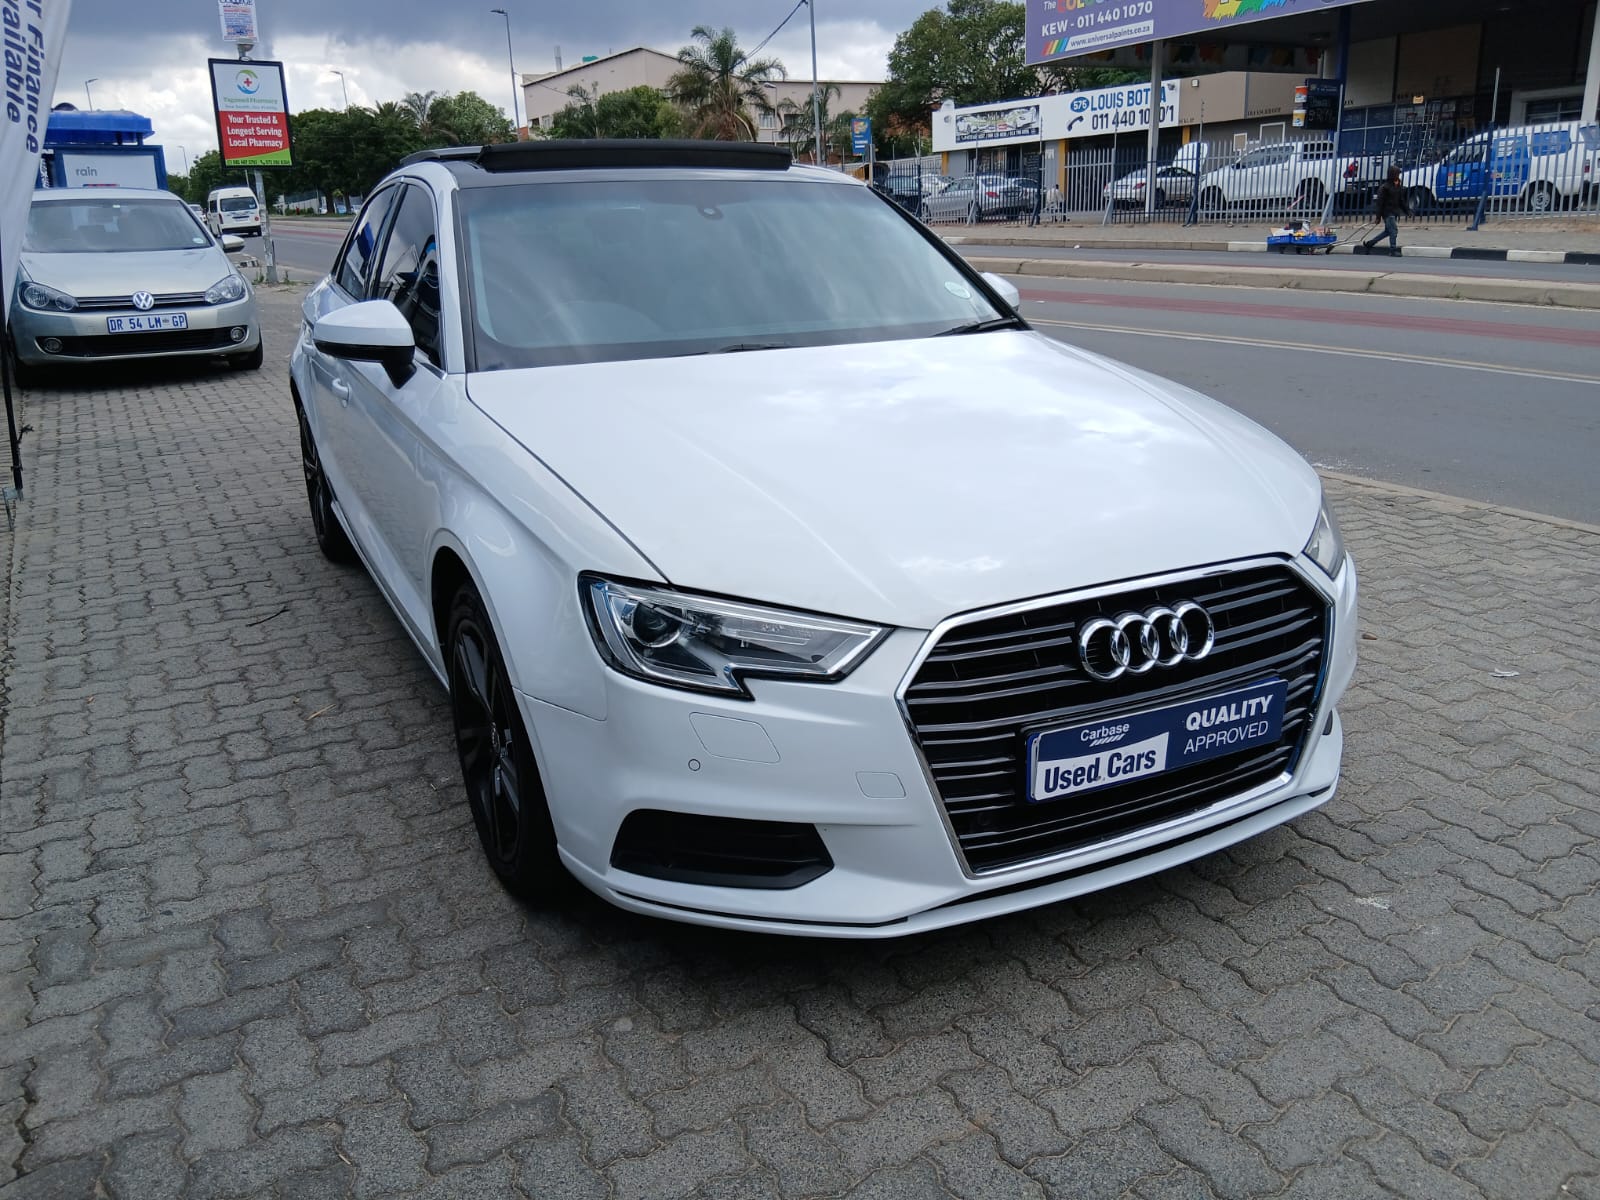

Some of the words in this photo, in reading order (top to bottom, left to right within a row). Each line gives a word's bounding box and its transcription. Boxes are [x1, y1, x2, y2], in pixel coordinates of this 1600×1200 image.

[1042, 20, 1068, 37] KEW
[1077, 13, 1094, 29] 011
[1097, 9, 1120, 24] 440
[1123, 1, 1153, 18] 1070
[1070, 25, 1150, 47] www.universalpaints.co.za
[26, 24, 45, 154] Finance
[1073, 101, 1087, 110] 575
[1091, 92, 1124, 111] LOUIS
[1127, 86, 1167, 106] BOTA
[228, 115, 244, 124] Your
[245, 115, 271, 124] Trusted
[272, 116, 278, 124] &
[1092, 113, 1109, 130] 011
[1112, 110, 1136, 127] 440
[1139, 105, 1174, 125] 100/1
[227, 126, 254, 137] Longest
[256, 127, 282, 137] Serving
[229, 138, 247, 147] Local
[249, 139, 283, 149] Pharmacy
[75, 166, 98, 177] rain
[110, 318, 123, 331] DR
[129, 317, 142, 330] 54
[172, 315, 185, 327] GP
[1186, 694, 1273, 732] QUALITY
[1080, 723, 1130, 742] Carbase
[1184, 720, 1269, 755] APPROVED
[1044, 757, 1100, 793] Used
[1107, 750, 1156, 778] Cars
